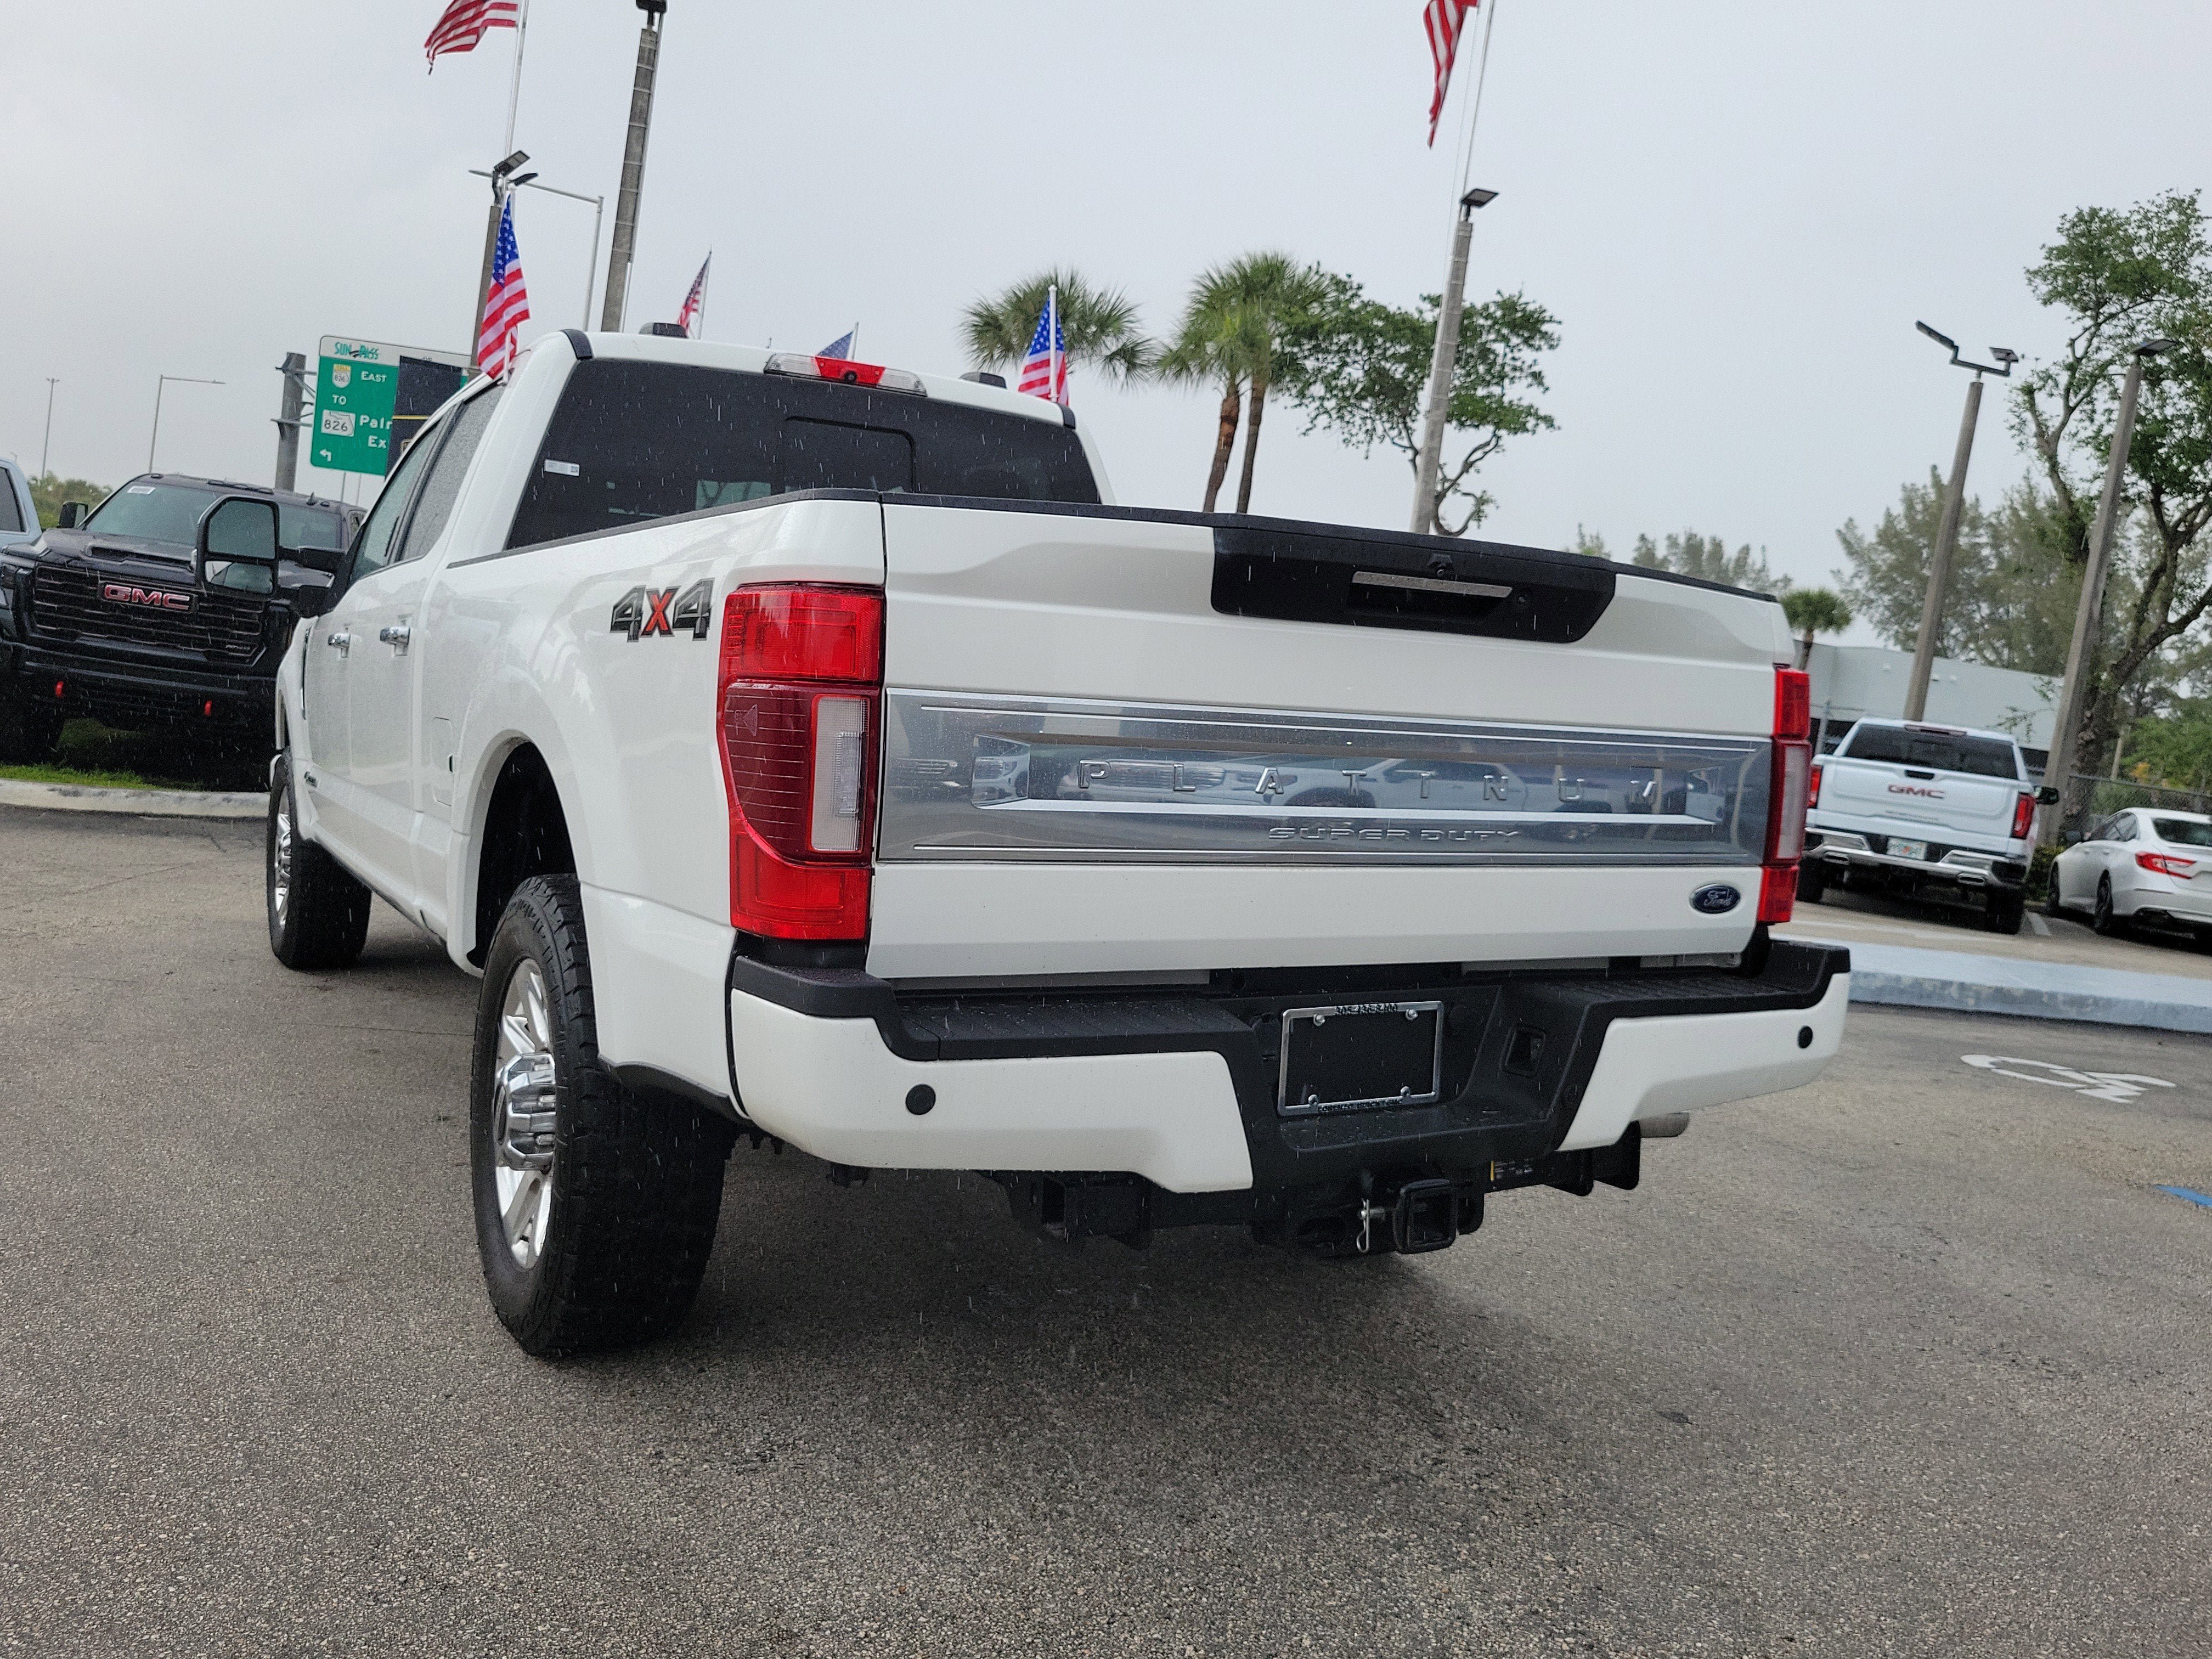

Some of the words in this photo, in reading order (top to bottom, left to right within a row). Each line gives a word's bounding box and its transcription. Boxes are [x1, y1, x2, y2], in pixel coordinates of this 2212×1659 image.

[361, 370, 387, 382] EAST
[332, 394, 347, 405] TO
[324, 419, 348, 432] 826
[104, 584, 190, 610] GMC
[1078, 759, 1657, 805] PLATINUM
[1888, 784, 1945, 799] GMC
[1269, 827, 1410, 840] SUPER
[1420, 830, 1519, 842] DUTY
[1703, 889, 1732, 906] Ford
